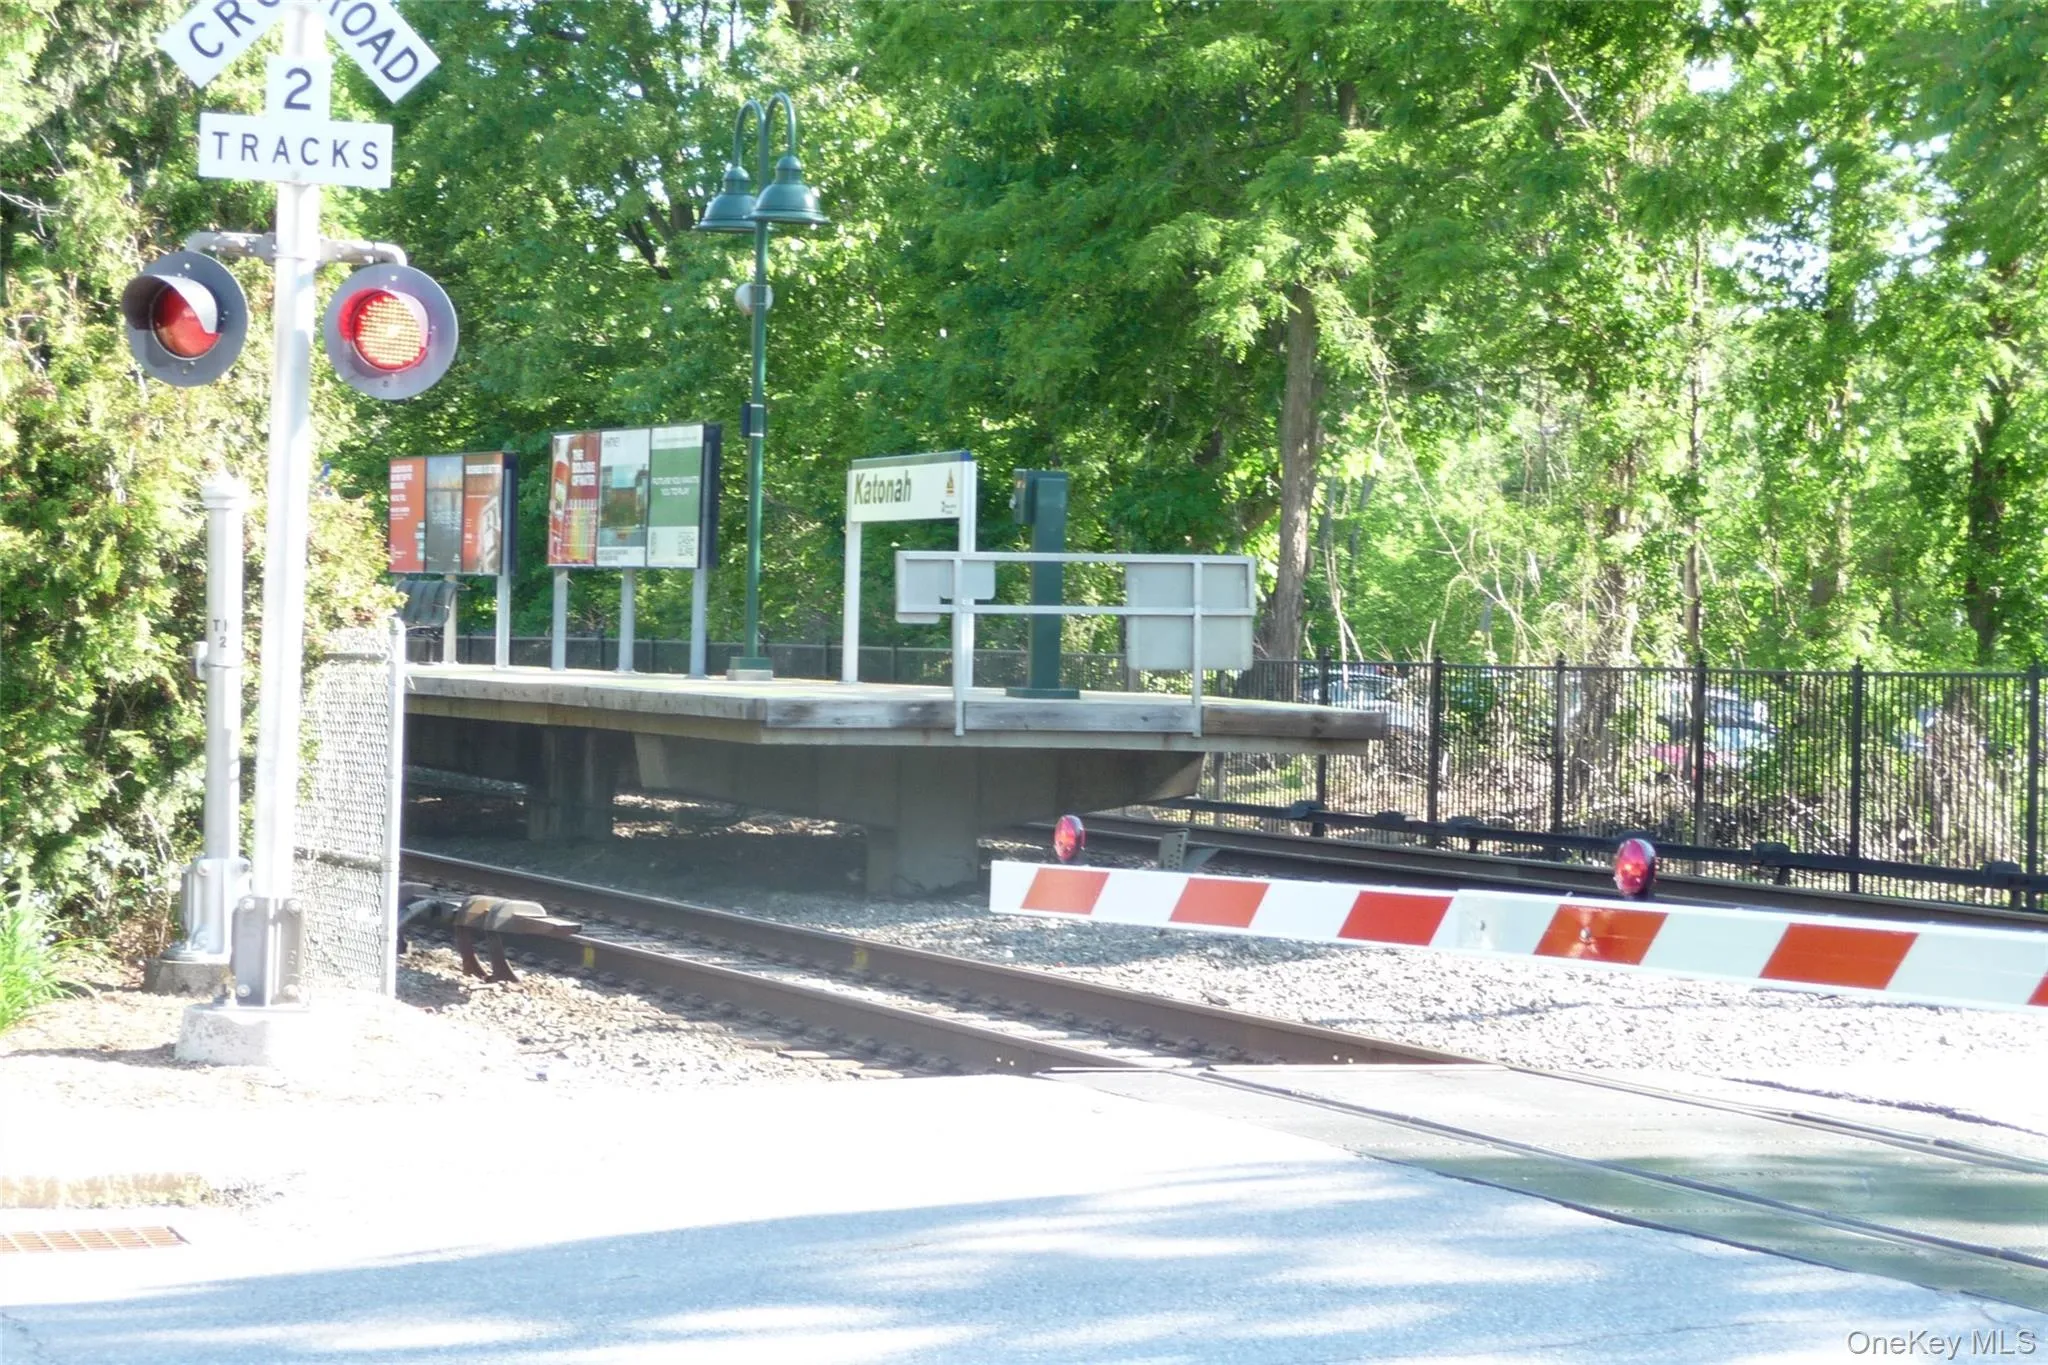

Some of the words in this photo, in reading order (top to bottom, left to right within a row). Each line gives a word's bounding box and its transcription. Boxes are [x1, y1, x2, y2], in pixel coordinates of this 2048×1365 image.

[188, 0, 281, 59] CR
[283, 66, 313, 111] 2
[211, 130, 379, 171] TRACKS
[853, 469, 912, 505] Katonah
[219, 636, 227, 648] 2
